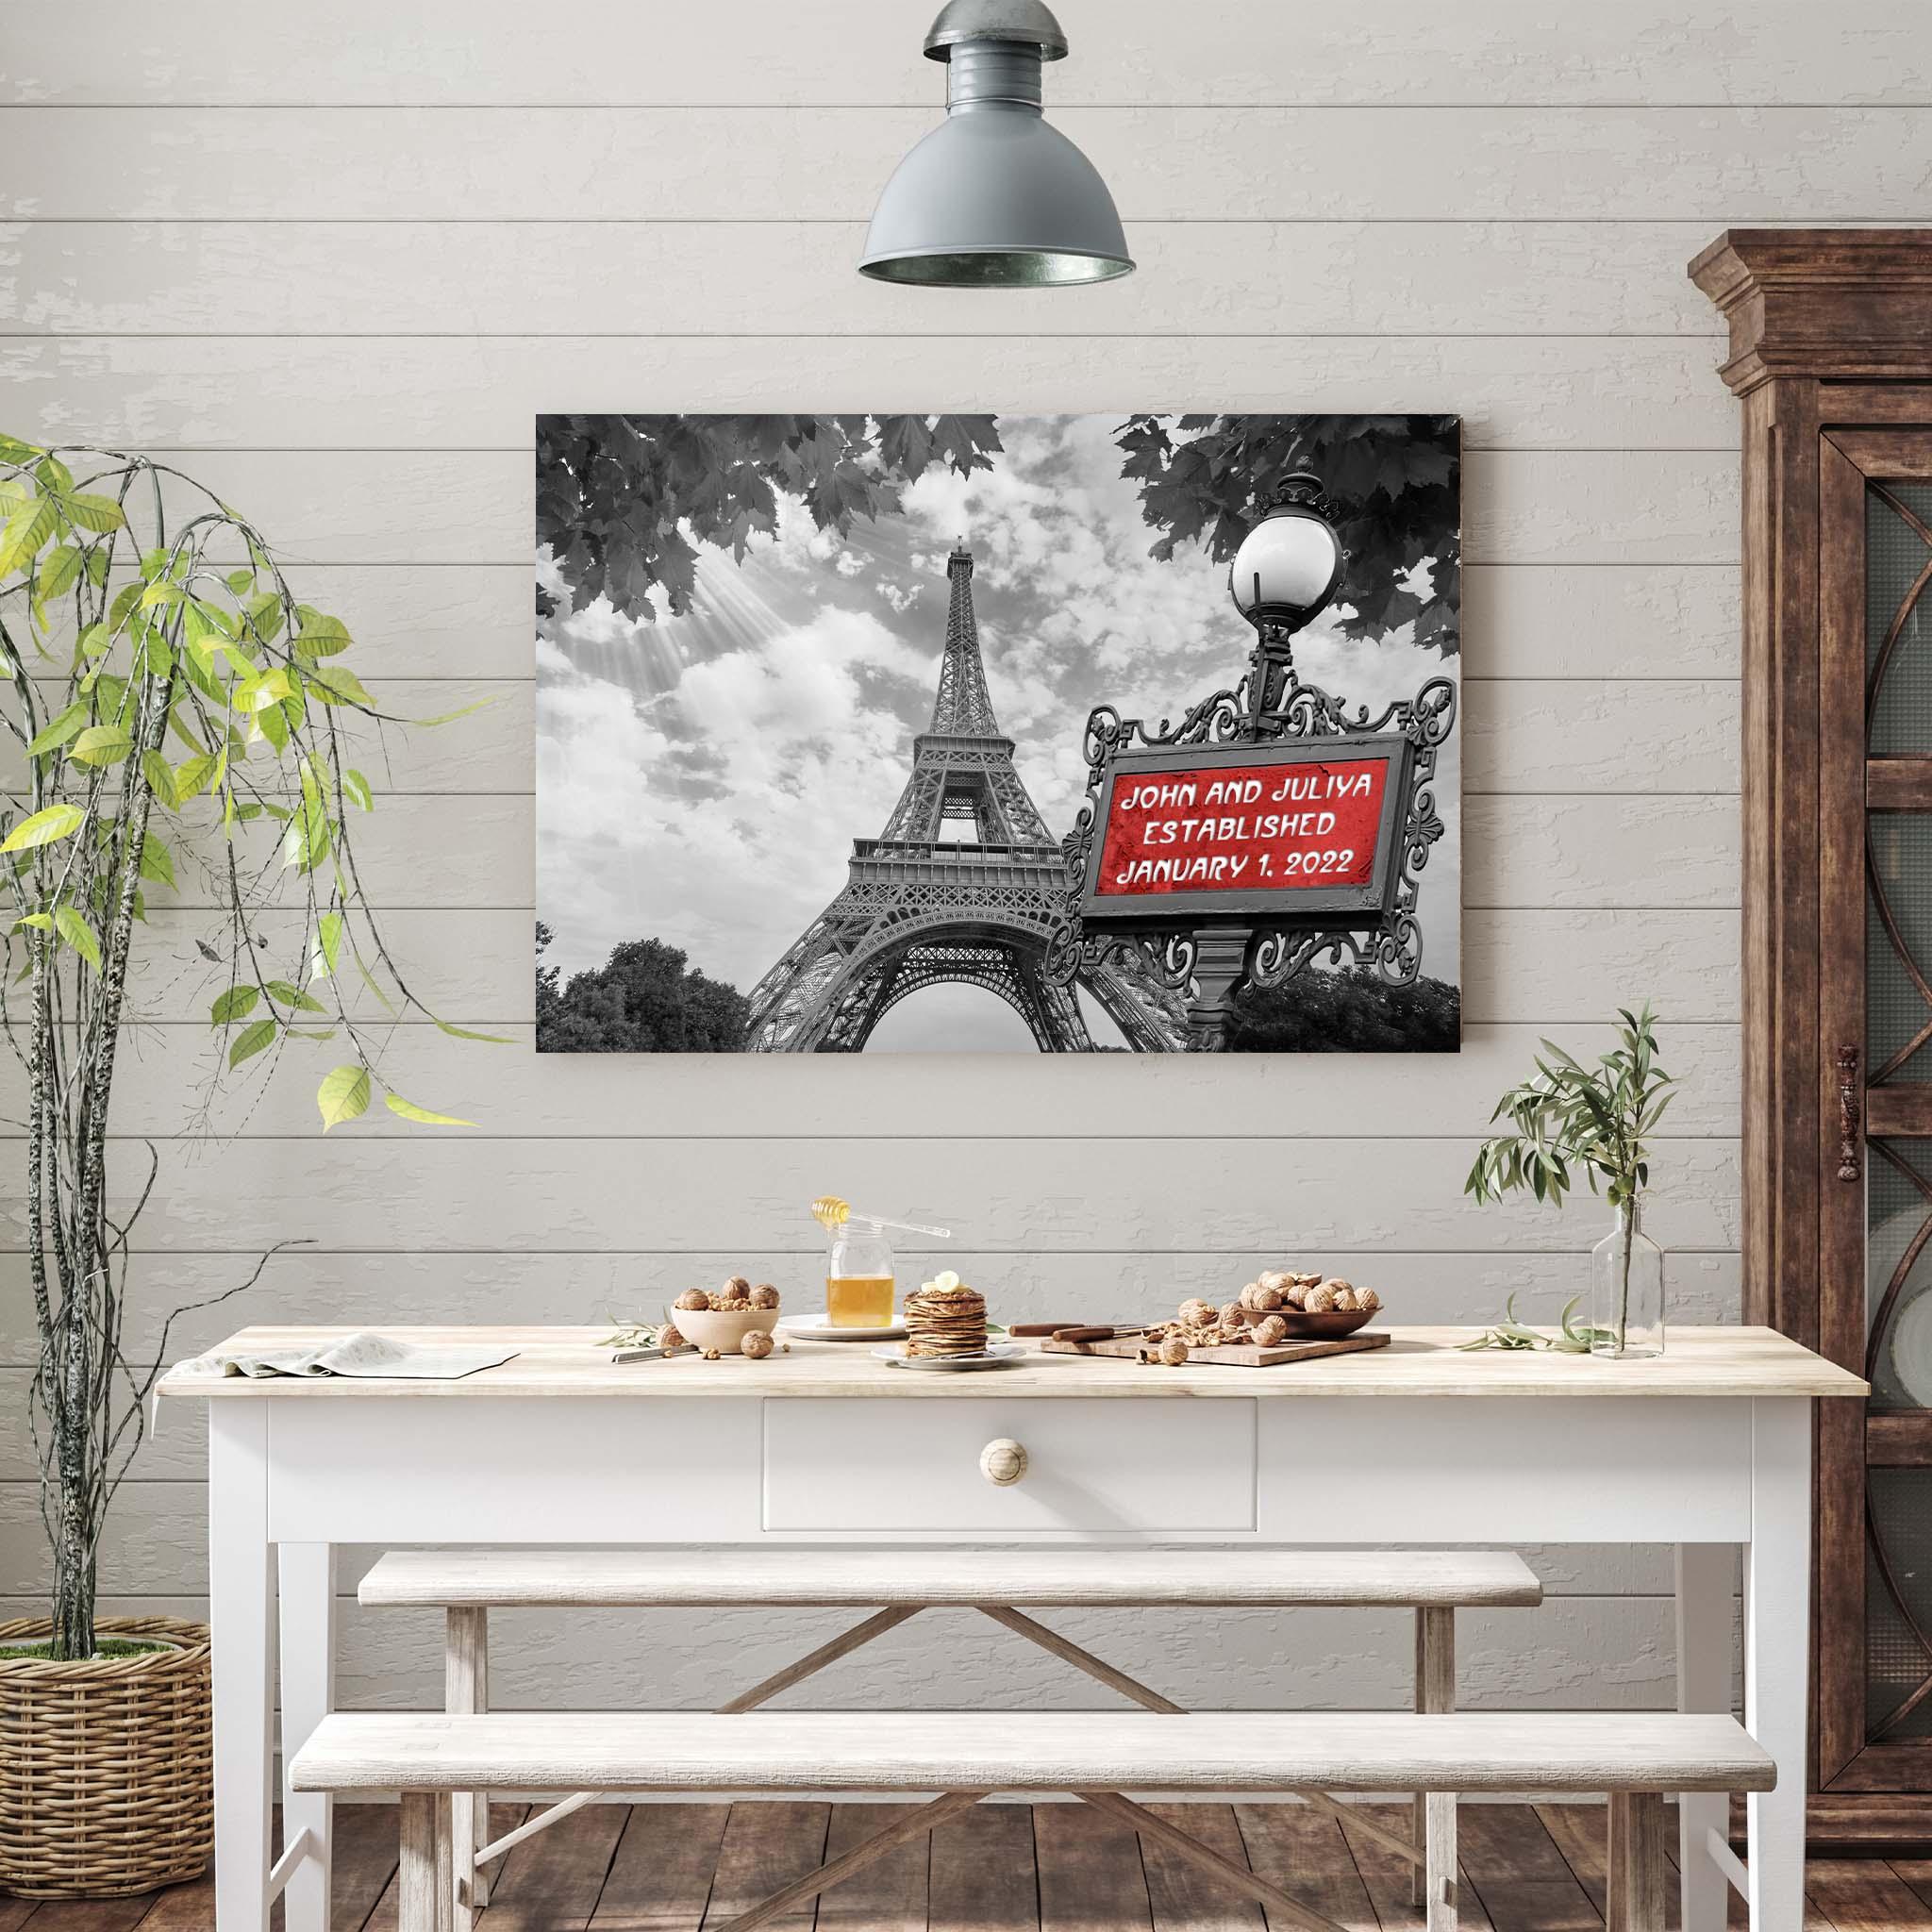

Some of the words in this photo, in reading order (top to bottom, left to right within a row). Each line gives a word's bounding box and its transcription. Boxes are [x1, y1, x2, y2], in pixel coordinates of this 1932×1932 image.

[1121, 785, 1197, 809] JOHN
[1204, 780, 1263, 806] AND
[1272, 774, 1372, 801] JULIYA
[1142, 812, 1337, 845] ESTABLISHED
[1116, 855, 1249, 885] JANUARY
[1283, 848, 1355, 876] 2022
